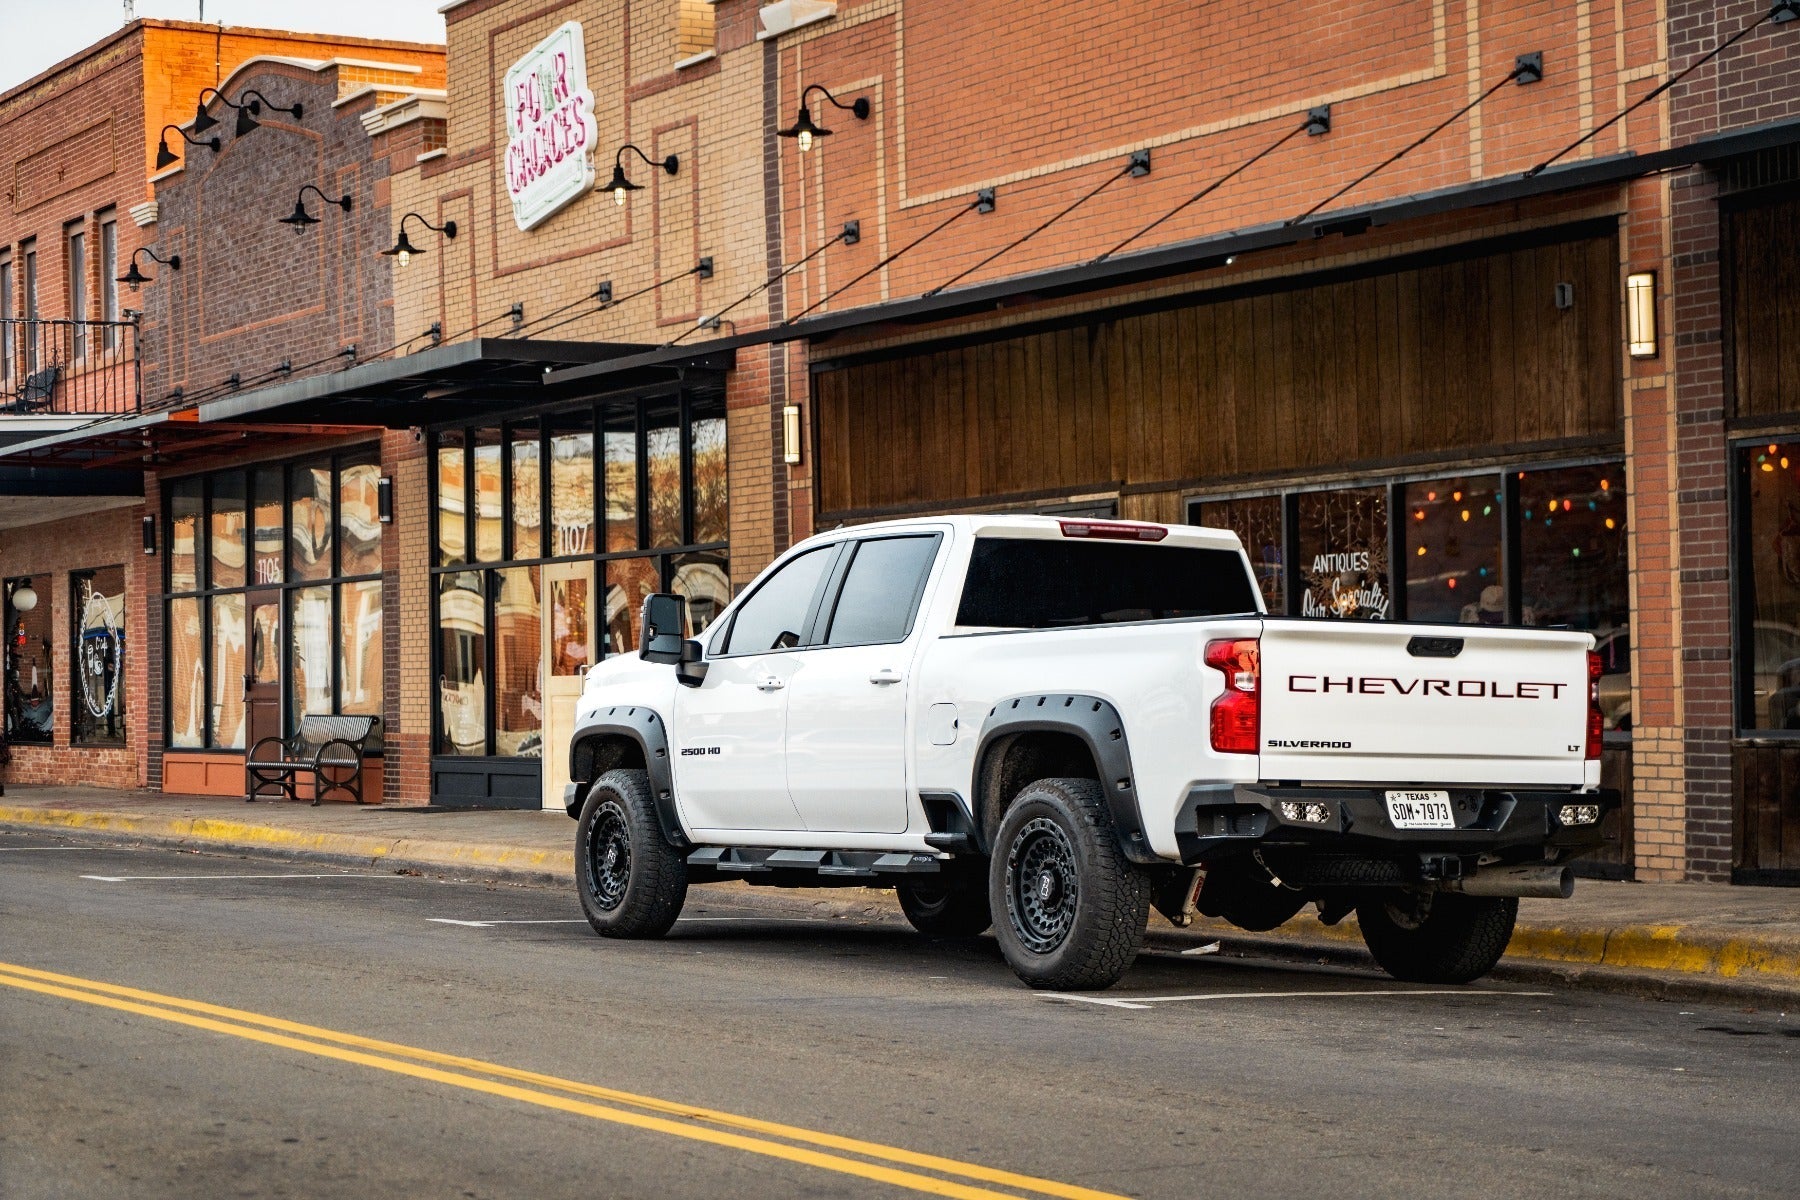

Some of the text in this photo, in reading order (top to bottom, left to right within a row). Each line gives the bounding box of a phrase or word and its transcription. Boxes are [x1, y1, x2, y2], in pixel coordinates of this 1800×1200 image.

[556, 523, 588, 555] 1107
[258, 557, 280, 585] 1105
[1312, 551, 1369, 573] ANTIQUES
[1329, 577, 1390, 620] Specialty
[1288, 675, 1568, 700] CHEVROLET
[681, 747, 706, 756] 2500
[1267, 739, 1352, 749] SILVERADO
[1567, 744, 1581, 752] LT
[1405, 793, 1430, 801] TEXAS
